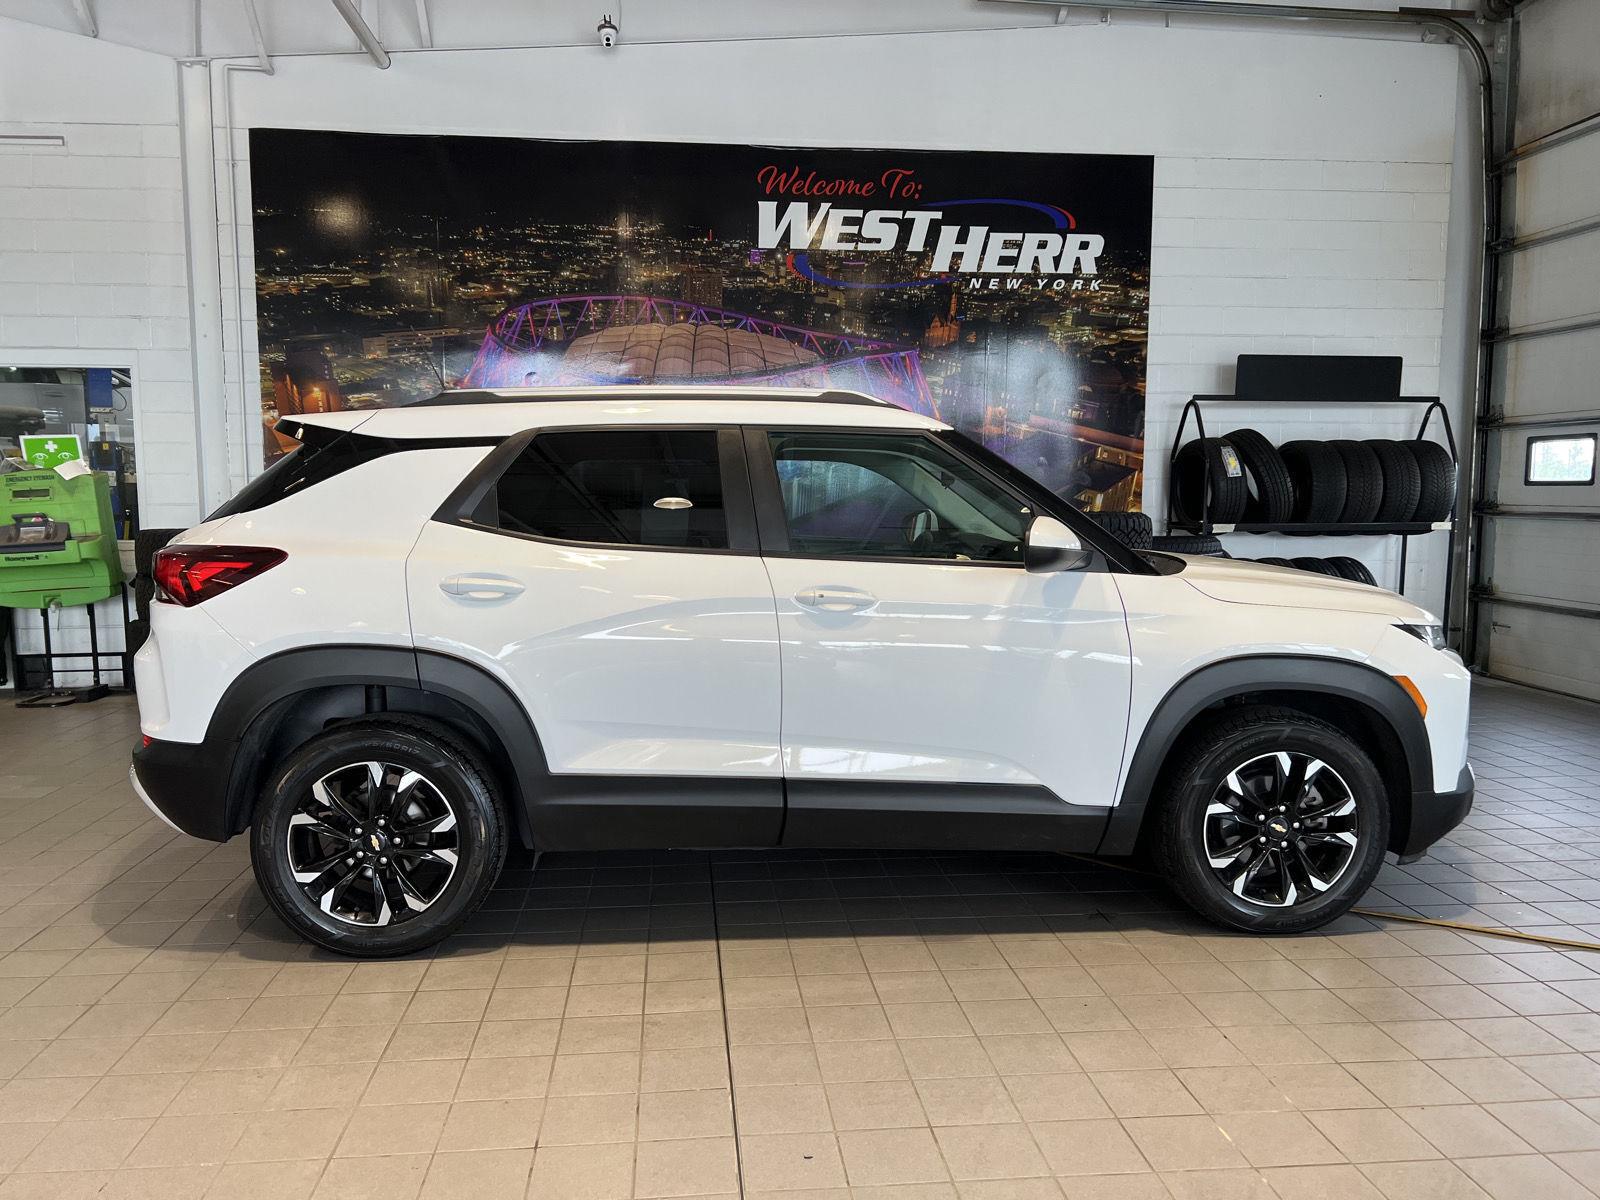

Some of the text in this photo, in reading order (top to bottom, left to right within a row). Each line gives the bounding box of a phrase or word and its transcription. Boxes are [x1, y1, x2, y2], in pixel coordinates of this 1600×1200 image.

[757, 165, 923, 199] Welcome To:
[757, 201, 1105, 274] WEST HERR
[969, 277, 1103, 291] NEW YORK
